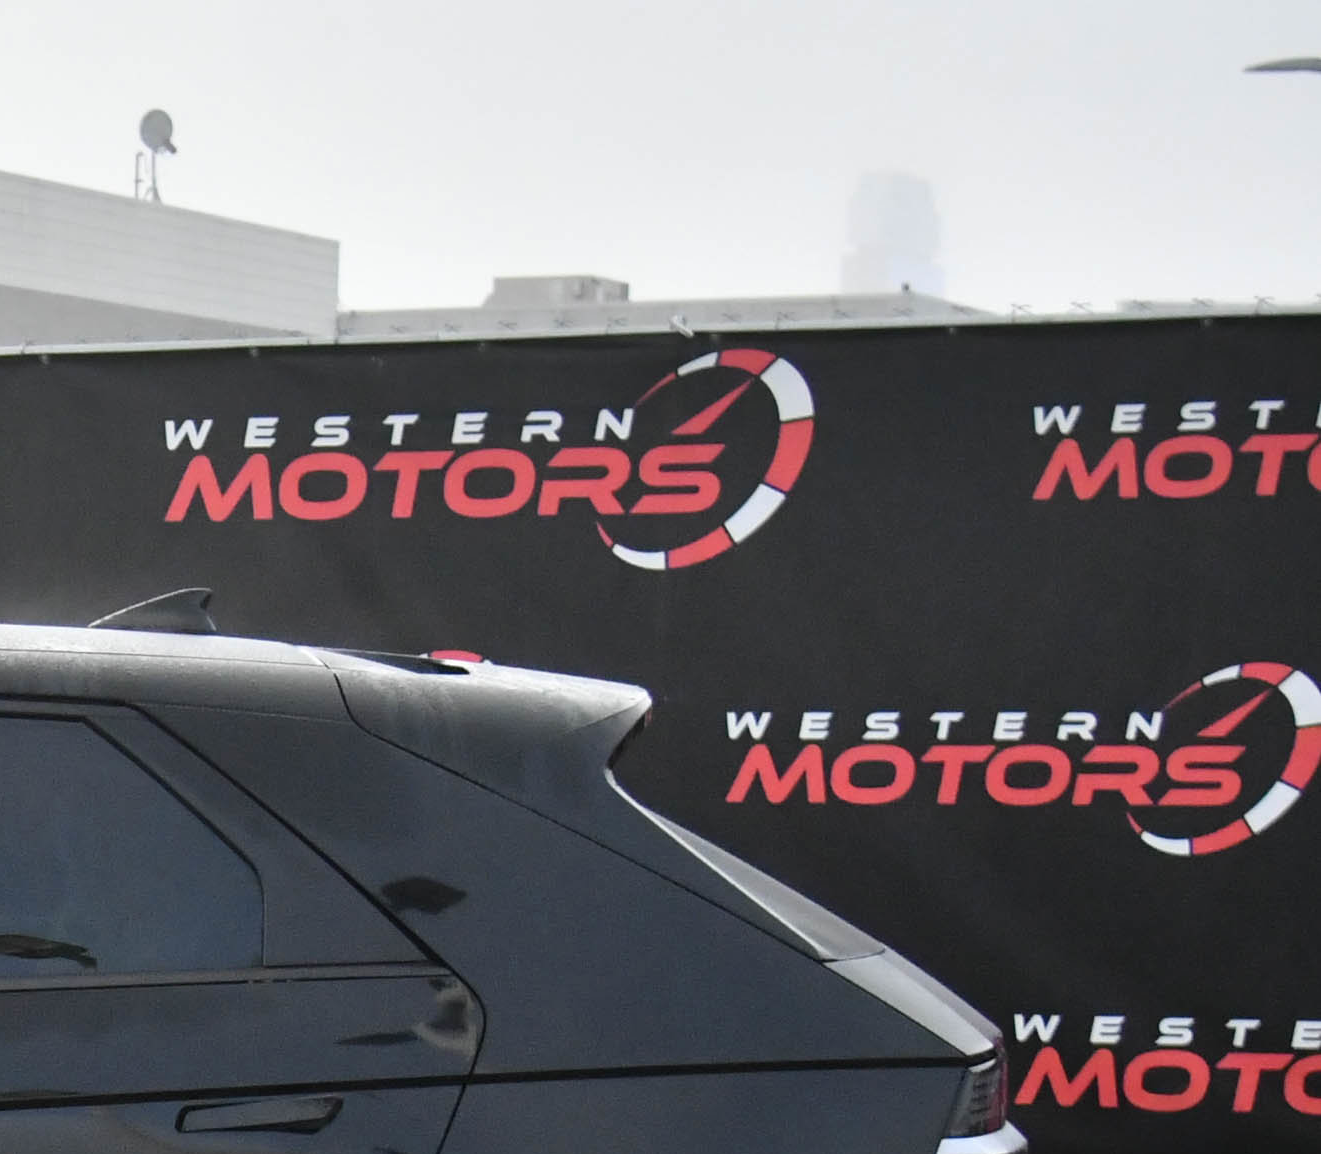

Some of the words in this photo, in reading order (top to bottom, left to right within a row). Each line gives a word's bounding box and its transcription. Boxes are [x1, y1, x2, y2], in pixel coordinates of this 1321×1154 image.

[164, 408, 634, 451] WESTERN
[1033, 400, 1321, 435] WEST
[163, 443, 727, 523] MOTORS
[1032, 433, 1321, 501] MOT
[726, 711, 1163, 742] WESTERN
[725, 743, 1247, 807] MOTORS
[1013, 1013, 1321, 1050] WESTE
